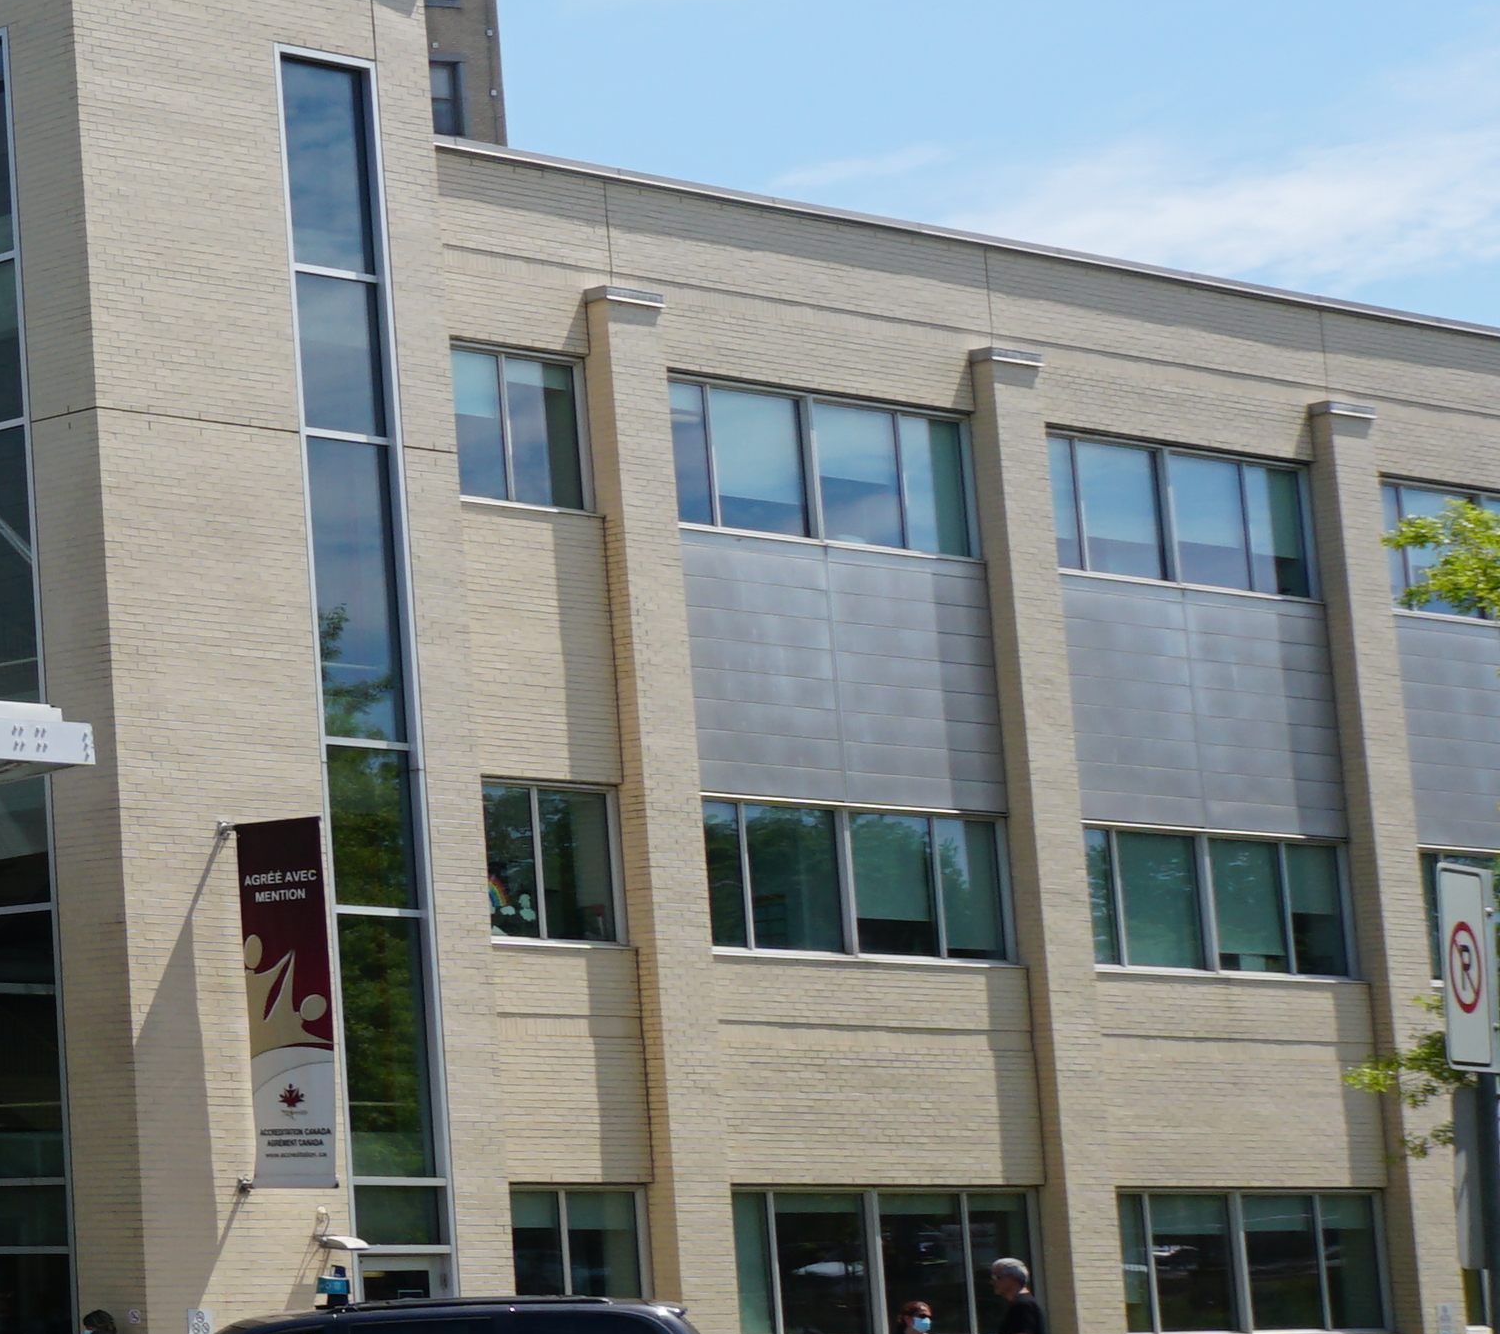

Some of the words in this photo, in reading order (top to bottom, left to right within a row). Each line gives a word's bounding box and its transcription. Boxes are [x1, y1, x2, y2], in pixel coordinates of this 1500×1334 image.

[244, 869, 283, 886] AGRÉÉ
[284, 869, 317, 883] AVEC
[255, 888, 306, 903] MENTION
